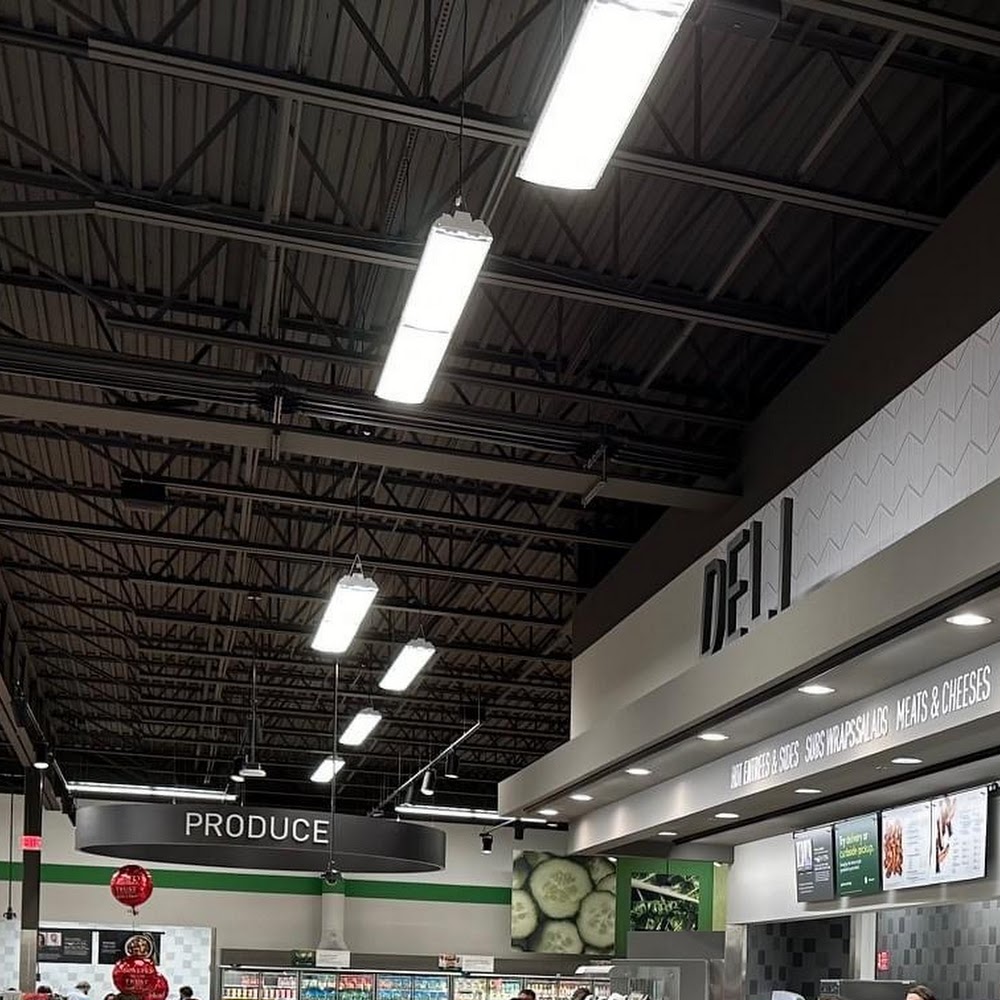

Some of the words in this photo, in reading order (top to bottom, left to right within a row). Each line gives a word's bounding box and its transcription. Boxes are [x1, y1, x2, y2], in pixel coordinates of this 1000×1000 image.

[701, 497, 793, 656] DELI
[896, 690, 928, 731] MEATS
[930, 686, 940, 718] &
[942, 665, 992, 716] CHEESES
[804, 729, 826, 762] SUBS
[826, 718, 855, 756] WRAPS
[854, 705, 889, 747] SALADS
[779, 740, 799, 773] SIDES
[185, 811, 330, 844] PRODUCE
